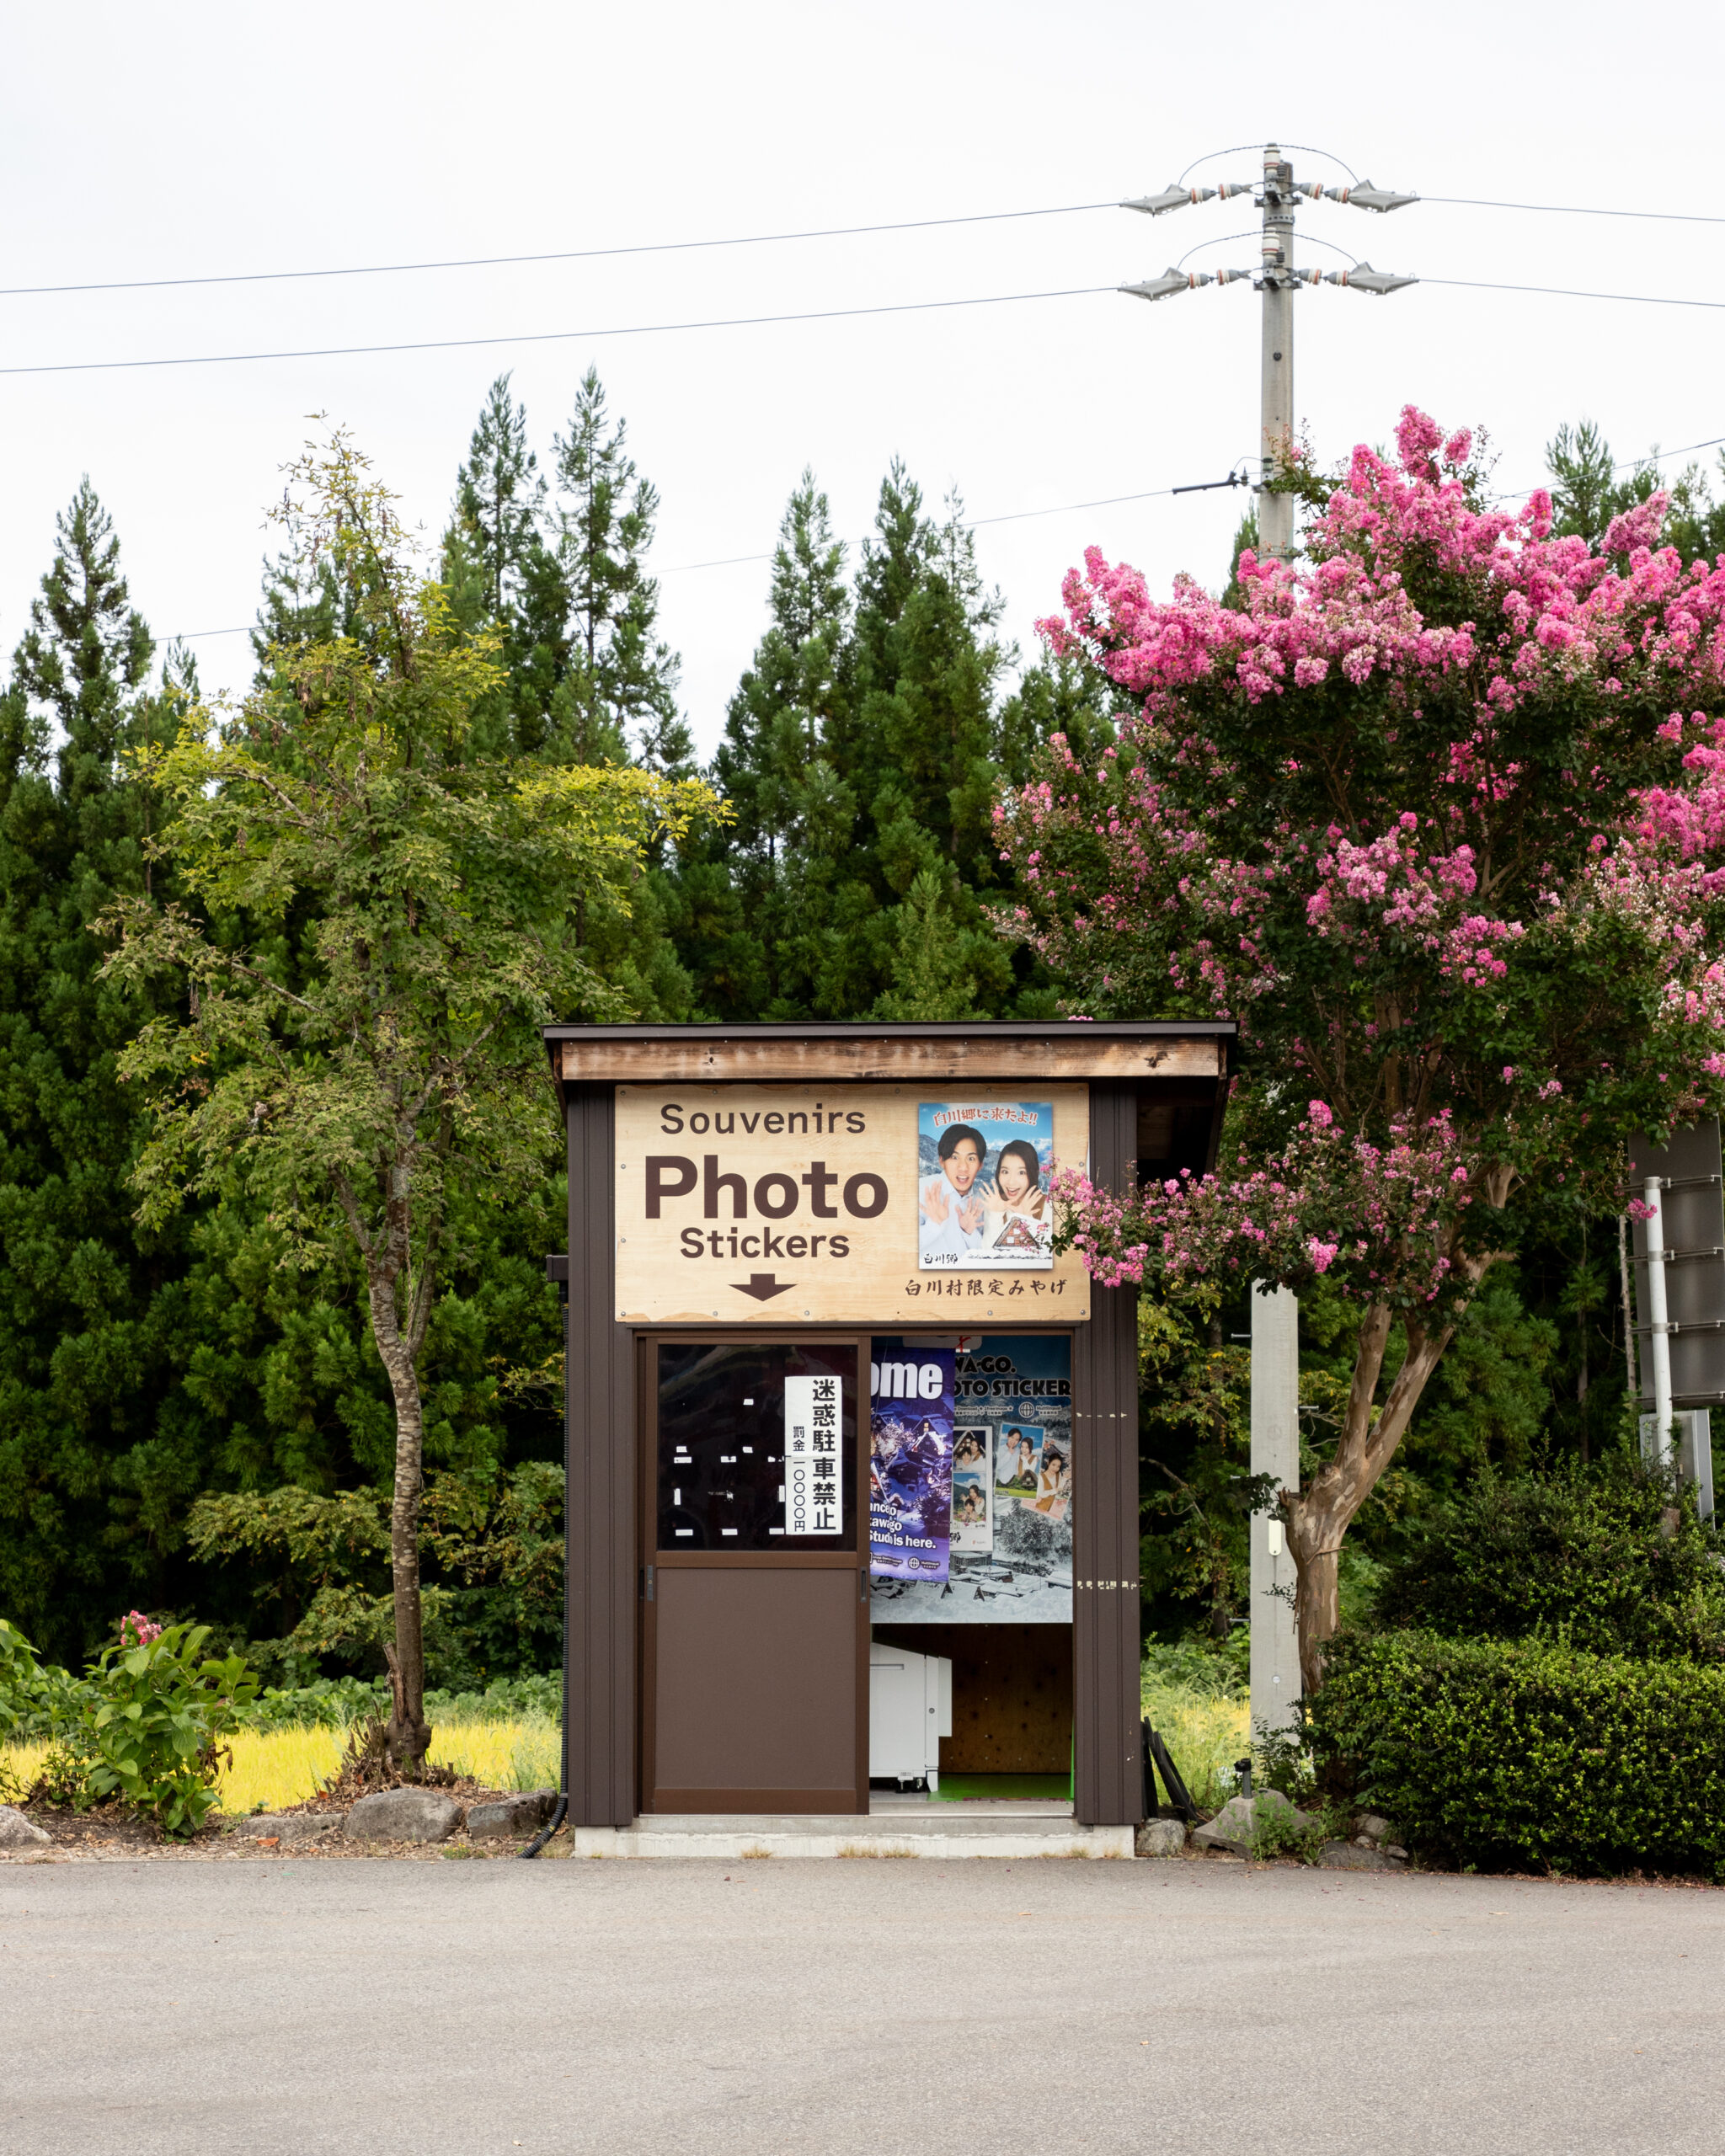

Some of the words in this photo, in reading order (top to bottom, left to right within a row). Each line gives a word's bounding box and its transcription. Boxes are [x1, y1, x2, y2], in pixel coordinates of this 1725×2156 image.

[660, 1102, 867, 1134] Souvenirs
[933, 1107, 1039, 1127] 白川郷に来たよ!!
[646, 1155, 888, 1219] Photo
[681, 1227, 849, 1257] Stickers
[905, 1278, 1068, 1297] 白川村限定みやげ
[992, 1379, 1071, 1396] STICKER
[812, 1379, 836, 1530] 迷惑駐車禁止
[905, 1534, 937, 1549] here.
